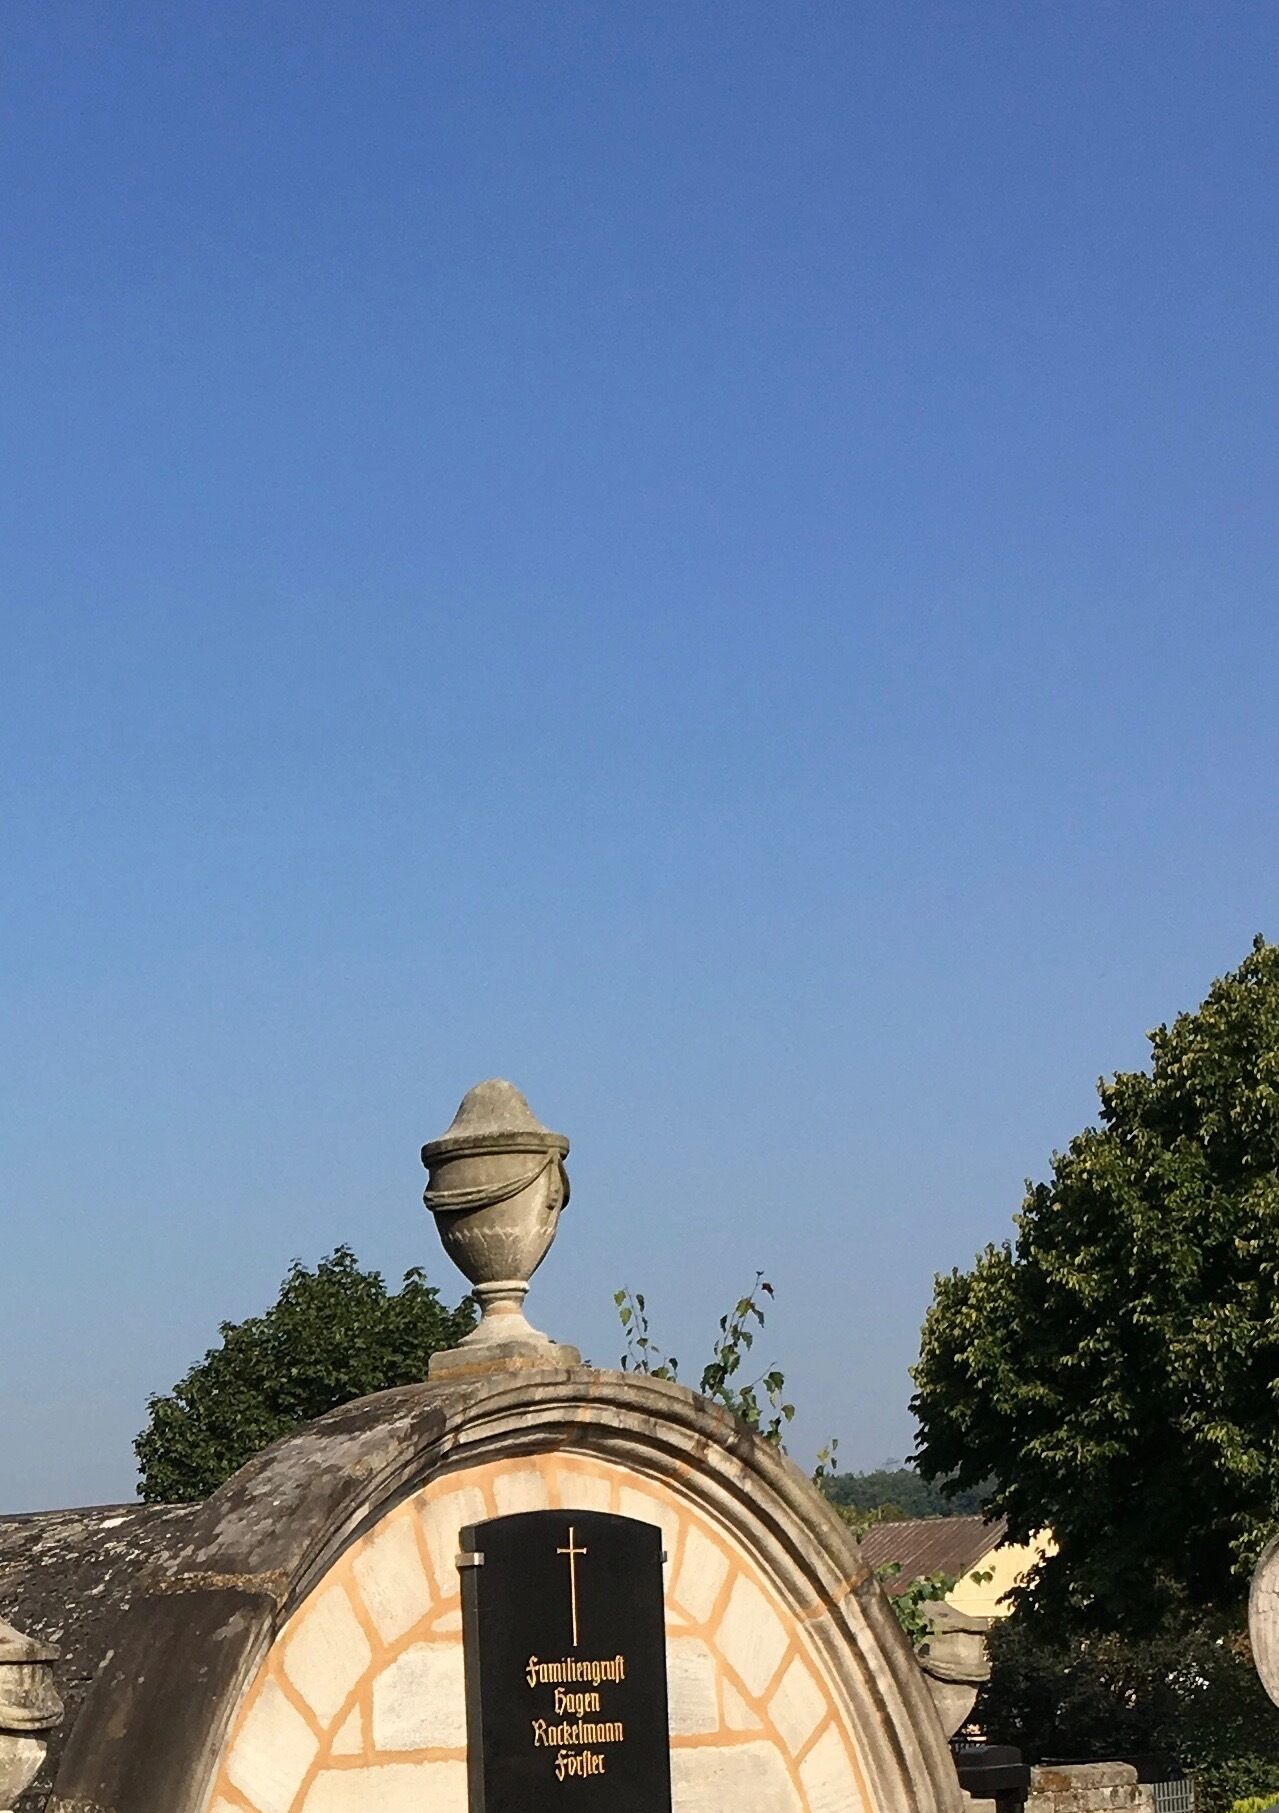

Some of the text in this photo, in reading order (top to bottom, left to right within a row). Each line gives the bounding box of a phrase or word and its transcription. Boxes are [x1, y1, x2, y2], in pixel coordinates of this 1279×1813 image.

[525, 1654, 625, 1688] Familiengruft
[554, 1686, 601, 1718] Hagen
[531, 1718, 624, 1747] Rackelmann
